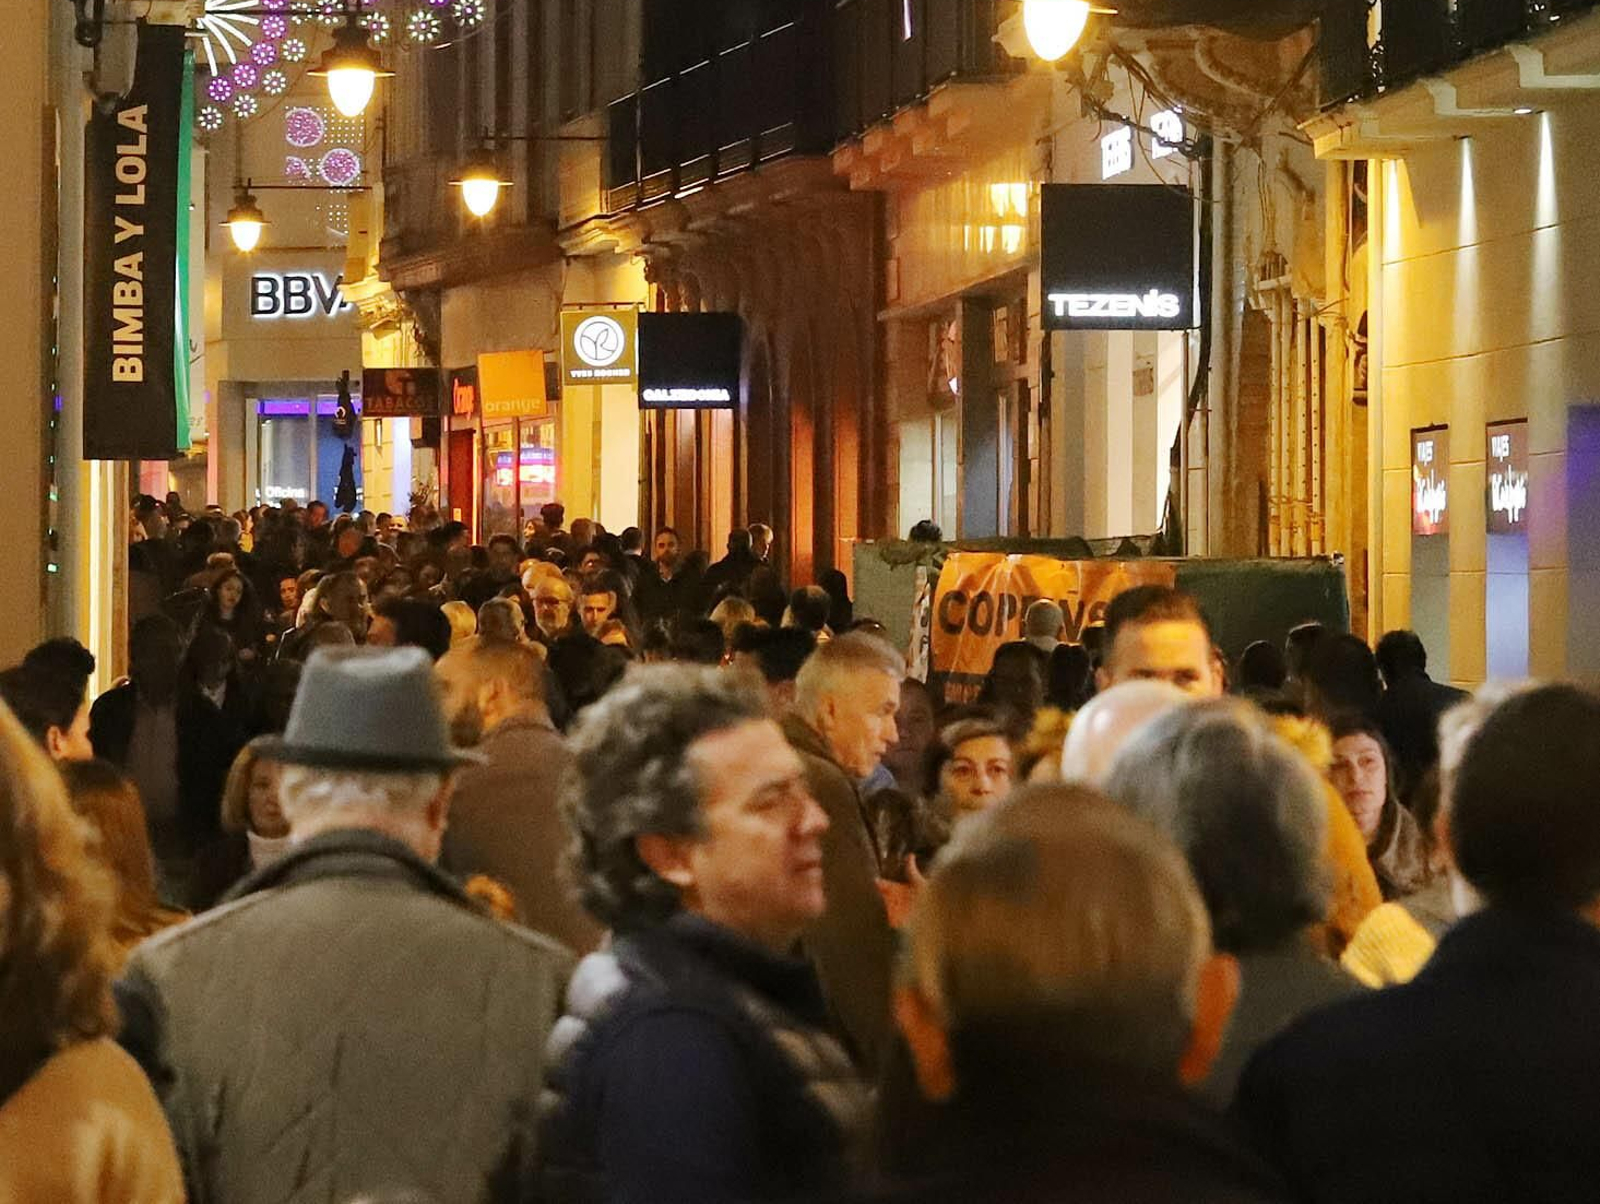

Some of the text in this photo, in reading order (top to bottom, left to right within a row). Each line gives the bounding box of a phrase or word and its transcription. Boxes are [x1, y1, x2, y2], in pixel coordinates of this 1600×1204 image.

[112, 104, 148, 382] BIMBA Y LOLA
[251, 275, 347, 315] BBV
[484, 398, 542, 414] orange
